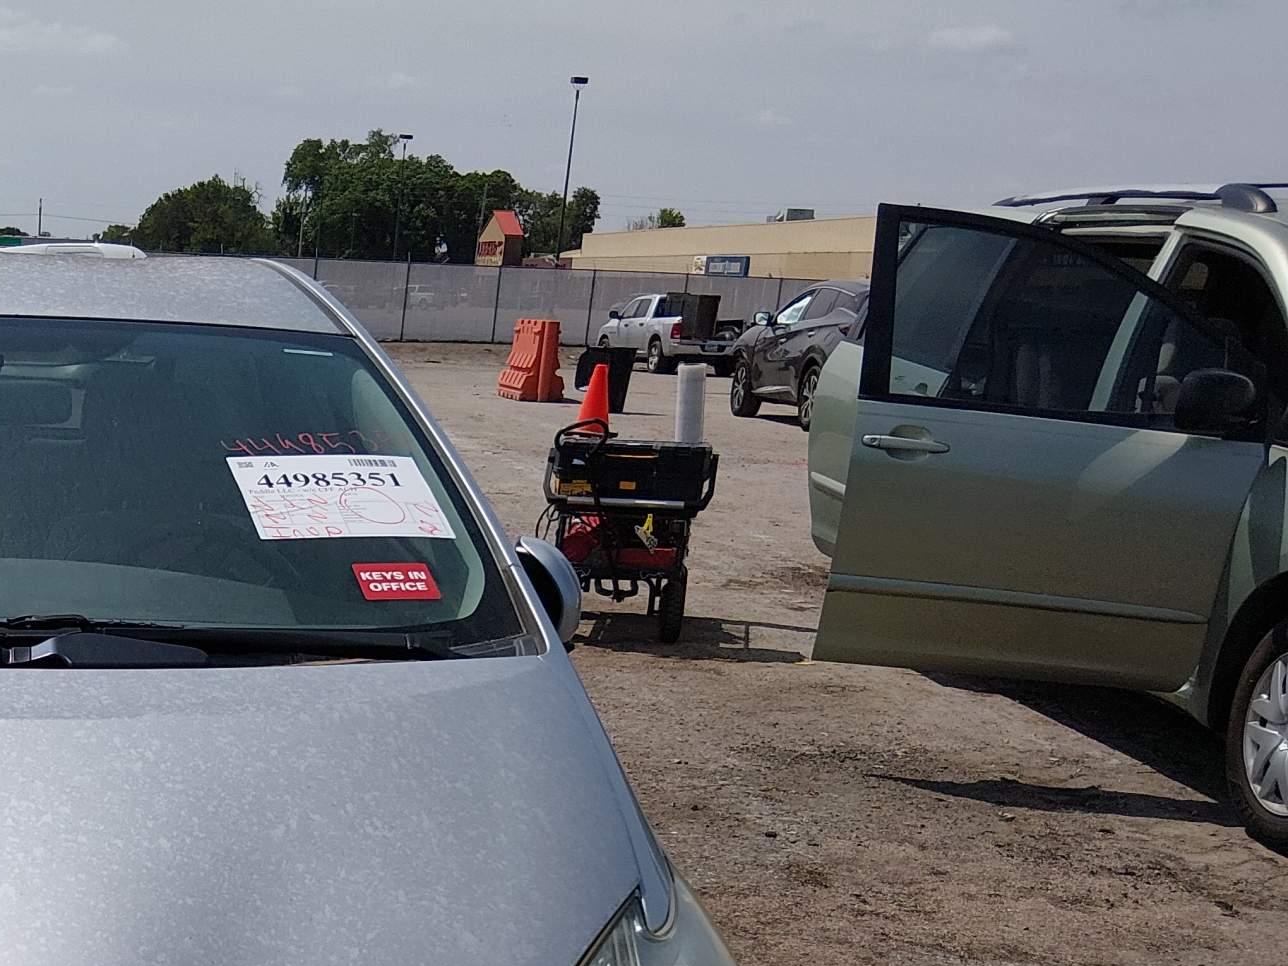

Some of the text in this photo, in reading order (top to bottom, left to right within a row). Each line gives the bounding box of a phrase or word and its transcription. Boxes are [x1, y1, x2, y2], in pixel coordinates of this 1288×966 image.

[257, 472, 402, 489] 44985351
[360, 571, 427, 581] KEYS IN
[369, 582, 429, 592] OFFICE
